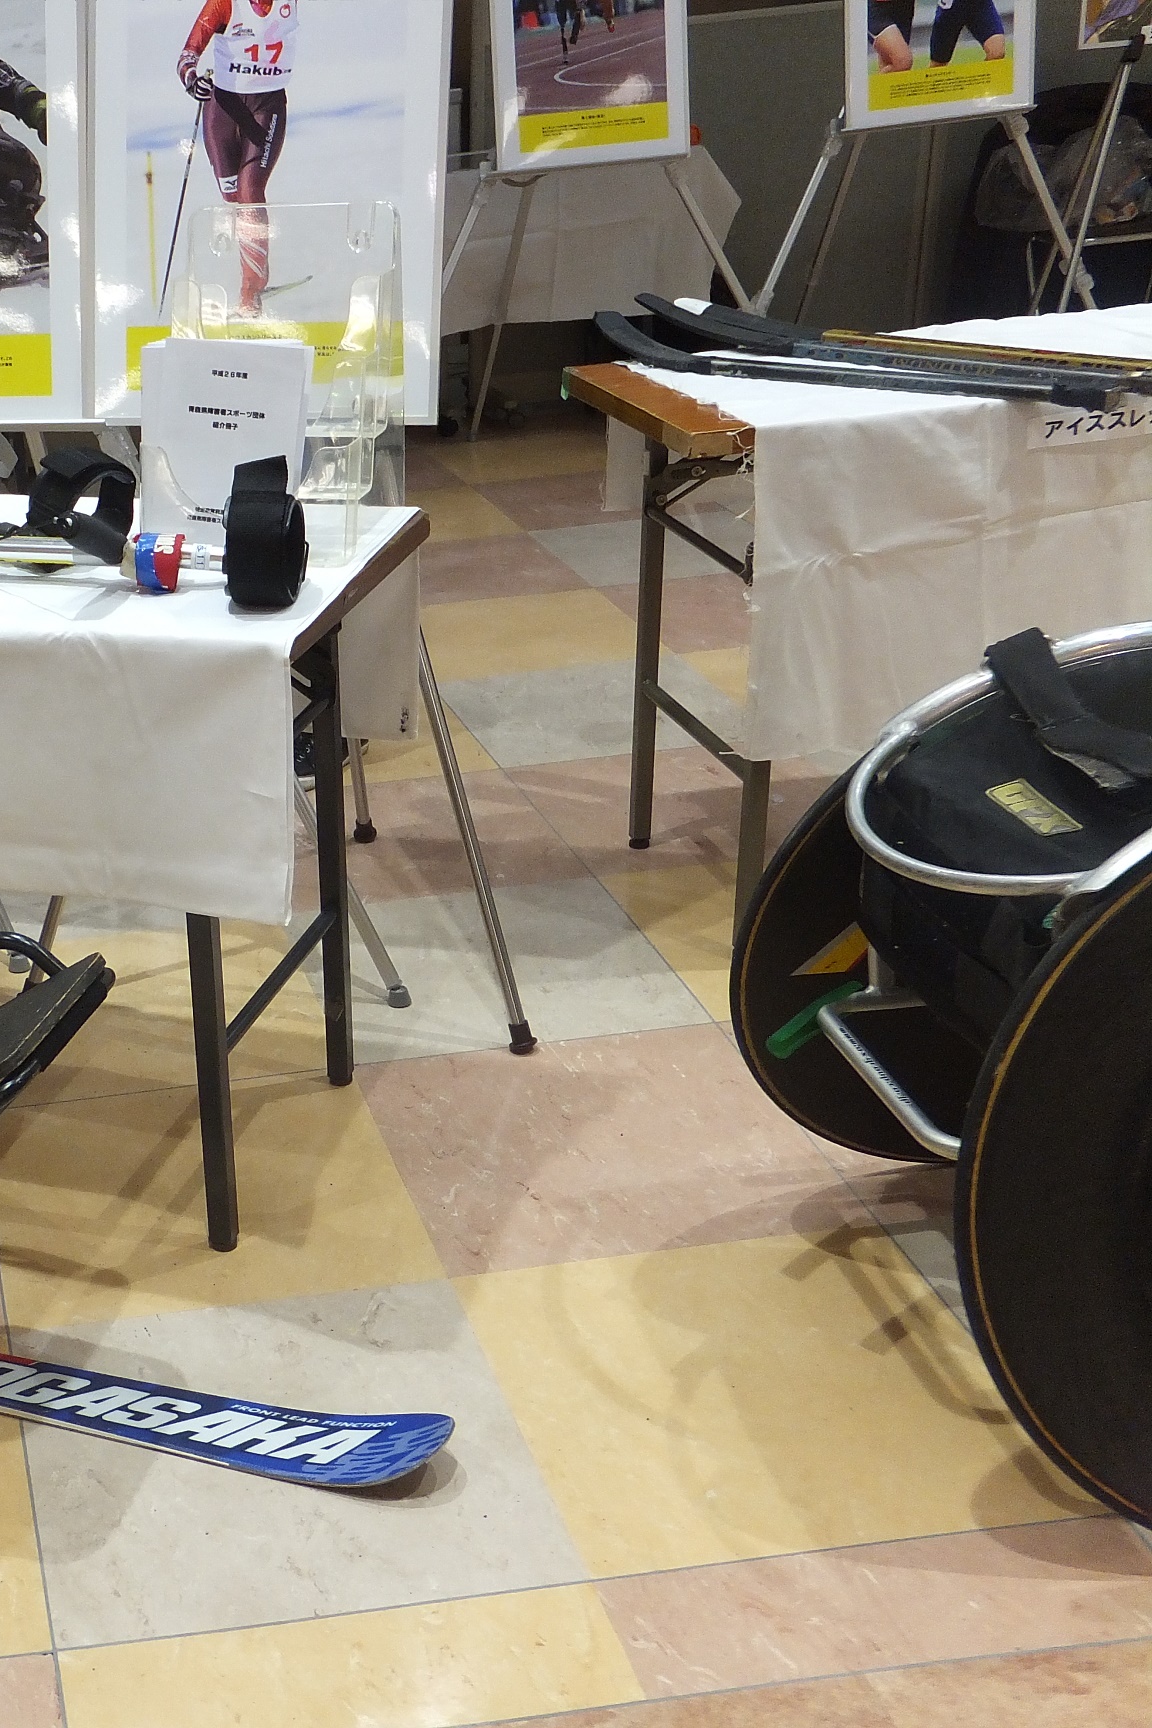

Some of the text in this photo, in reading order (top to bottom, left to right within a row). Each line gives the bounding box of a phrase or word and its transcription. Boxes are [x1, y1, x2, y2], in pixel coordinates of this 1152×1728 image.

[243, 41, 284, 65] 17
[1045, 409, 1152, 439] アイススレ
[230, 1403, 398, 1429] FRONT LEAD FUNCTION
